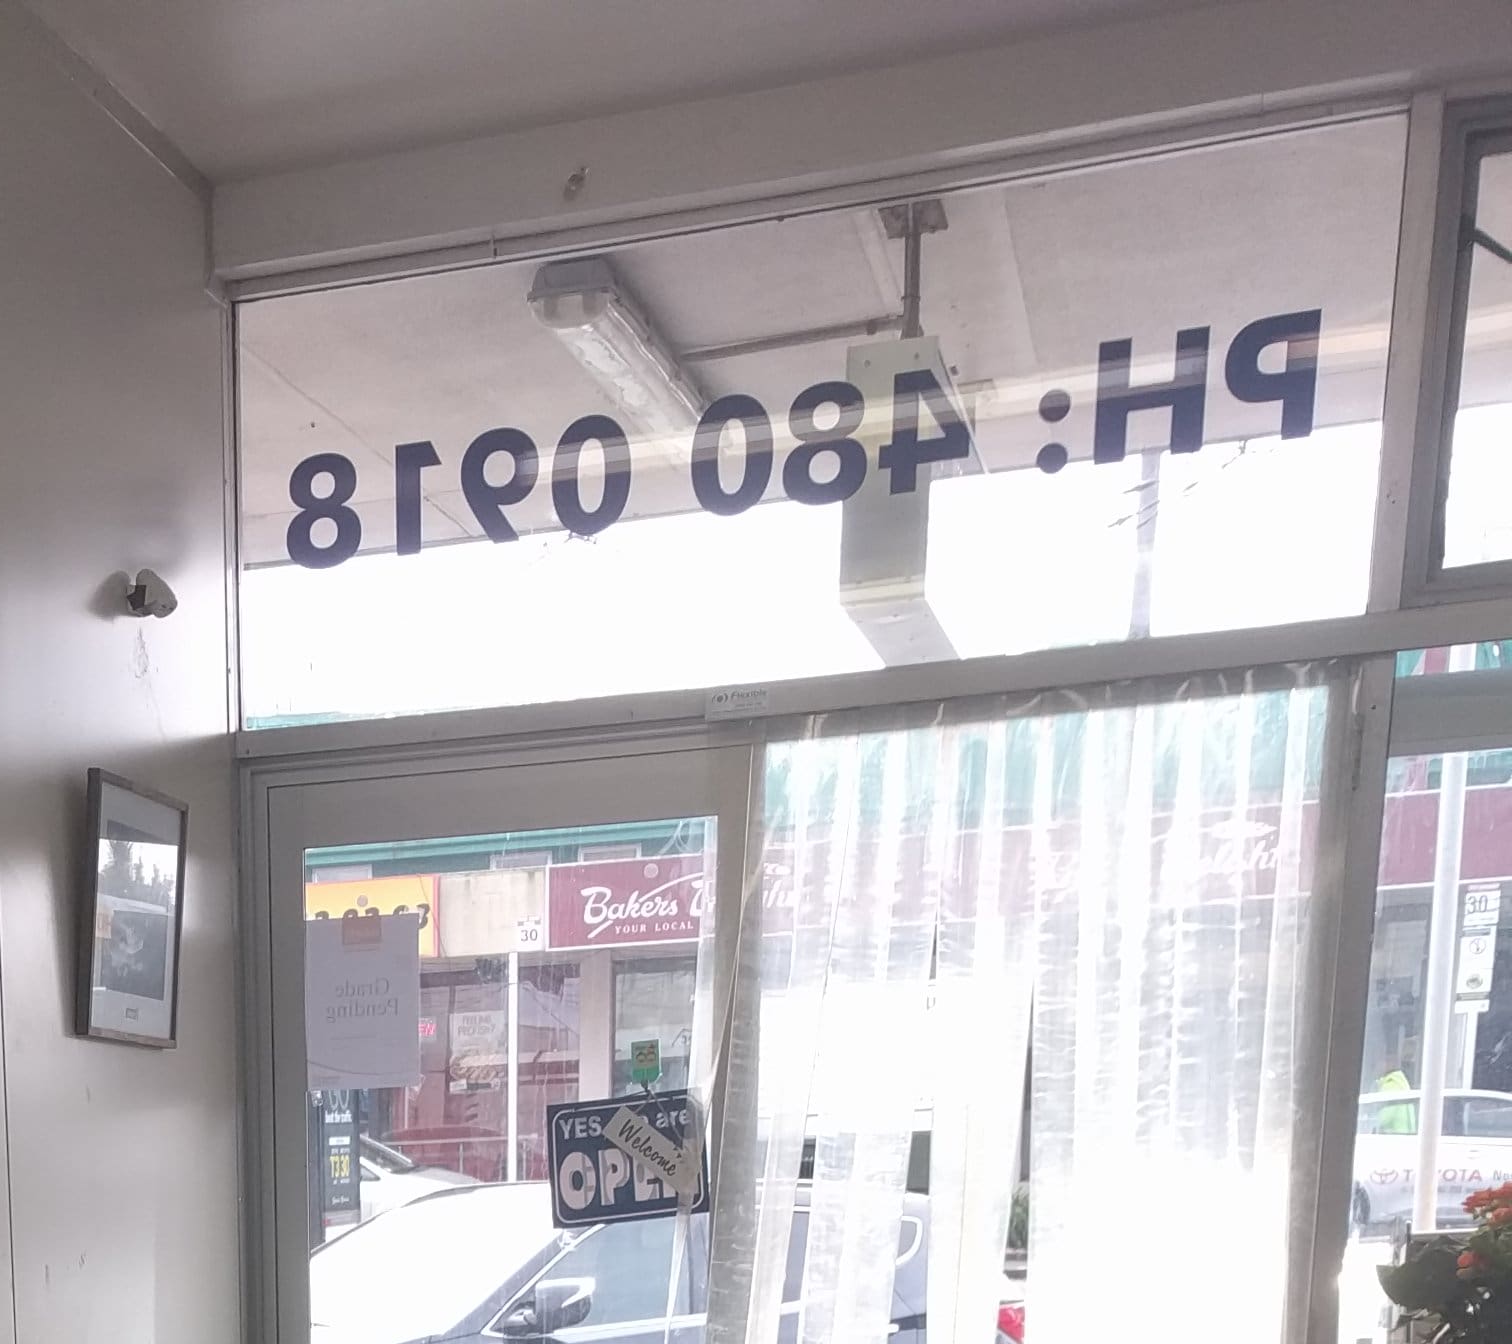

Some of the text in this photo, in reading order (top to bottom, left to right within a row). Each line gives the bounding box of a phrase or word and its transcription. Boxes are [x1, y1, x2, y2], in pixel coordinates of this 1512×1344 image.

[580, 885, 678, 932] Bakers
[519, 927, 539, 943] 30
[615, 920, 695, 935] YOUR LOCAL
[558, 1115, 602, 1140] YES
[655, 1108, 692, 1130] are
[618, 1118, 677, 1176] Welcome
[1403, 1168, 1483, 1182] TOTA
